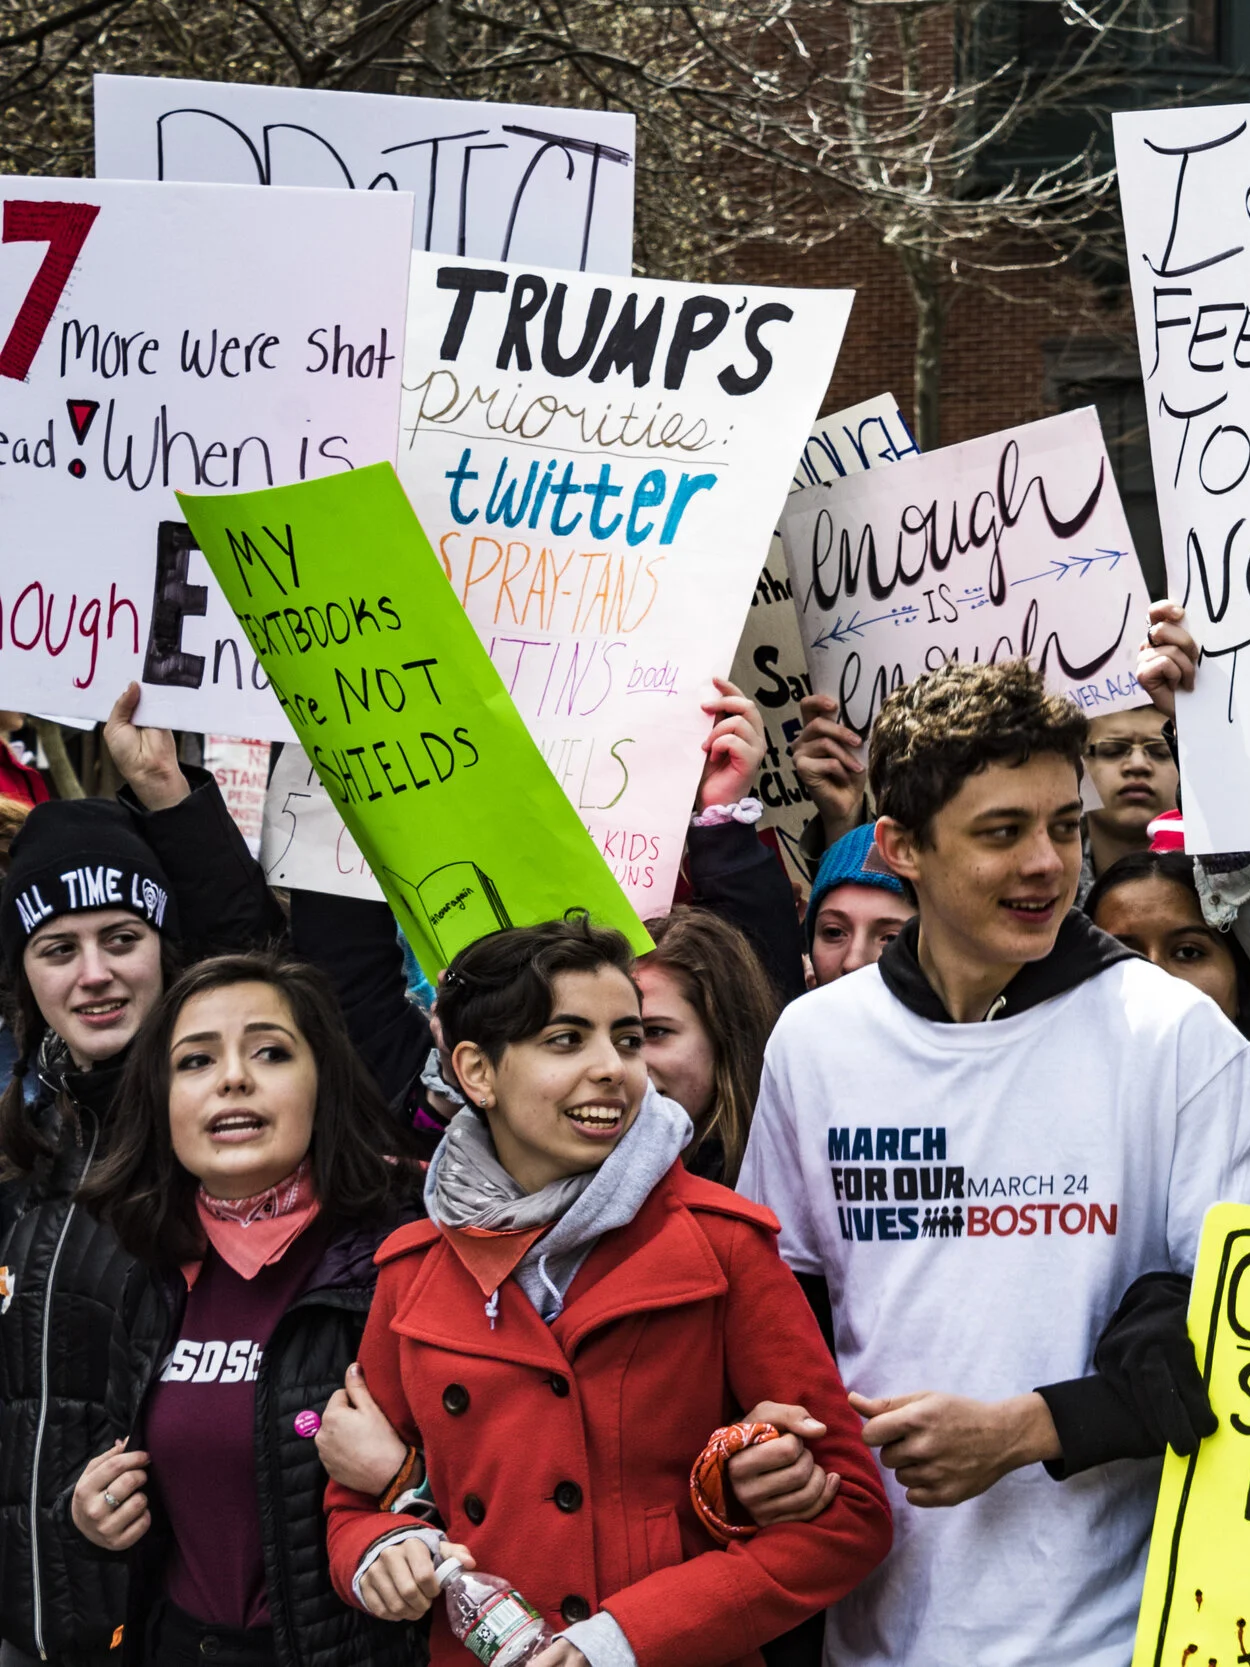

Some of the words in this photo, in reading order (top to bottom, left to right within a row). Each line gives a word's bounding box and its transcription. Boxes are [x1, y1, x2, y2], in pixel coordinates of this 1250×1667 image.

[1142, 120, 1248, 278] I
[0, 200, 101, 382] 7
[437, 267, 794, 396] TRUMP'S
[102, 398, 274, 492] When
[299, 418, 356, 481] is
[401, 369, 734, 451] priorities:
[445, 448, 718, 546] twitter
[803, 440, 1104, 626] enough
[225, 524, 301, 597] MY
[438, 532, 667, 634] SPRAY-TANS
[0, 581, 139, 689] ough
[922, 582, 960, 623] IS
[334, 658, 438, 724] NOT
[489, 636, 627, 717] TIN'S
[626, 659, 681, 697] body
[1068, 683, 1103, 710] VER
[312, 727, 479, 805] SHIELDS
[602, 829, 661, 862] KIDS
[15, 884, 54, 935] ALL
[60, 865, 124, 909] TIME
[828, 1127, 947, 1161] MARCH
[831, 1167, 890, 1201] FOR
[893, 1166, 965, 1200] OUR
[966, 1176, 1055, 1198] MARCH
[1062, 1174, 1090, 1195] 24
[966, 1203, 1118, 1237] BOSTON
[838, 1206, 919, 1242] LIVES
